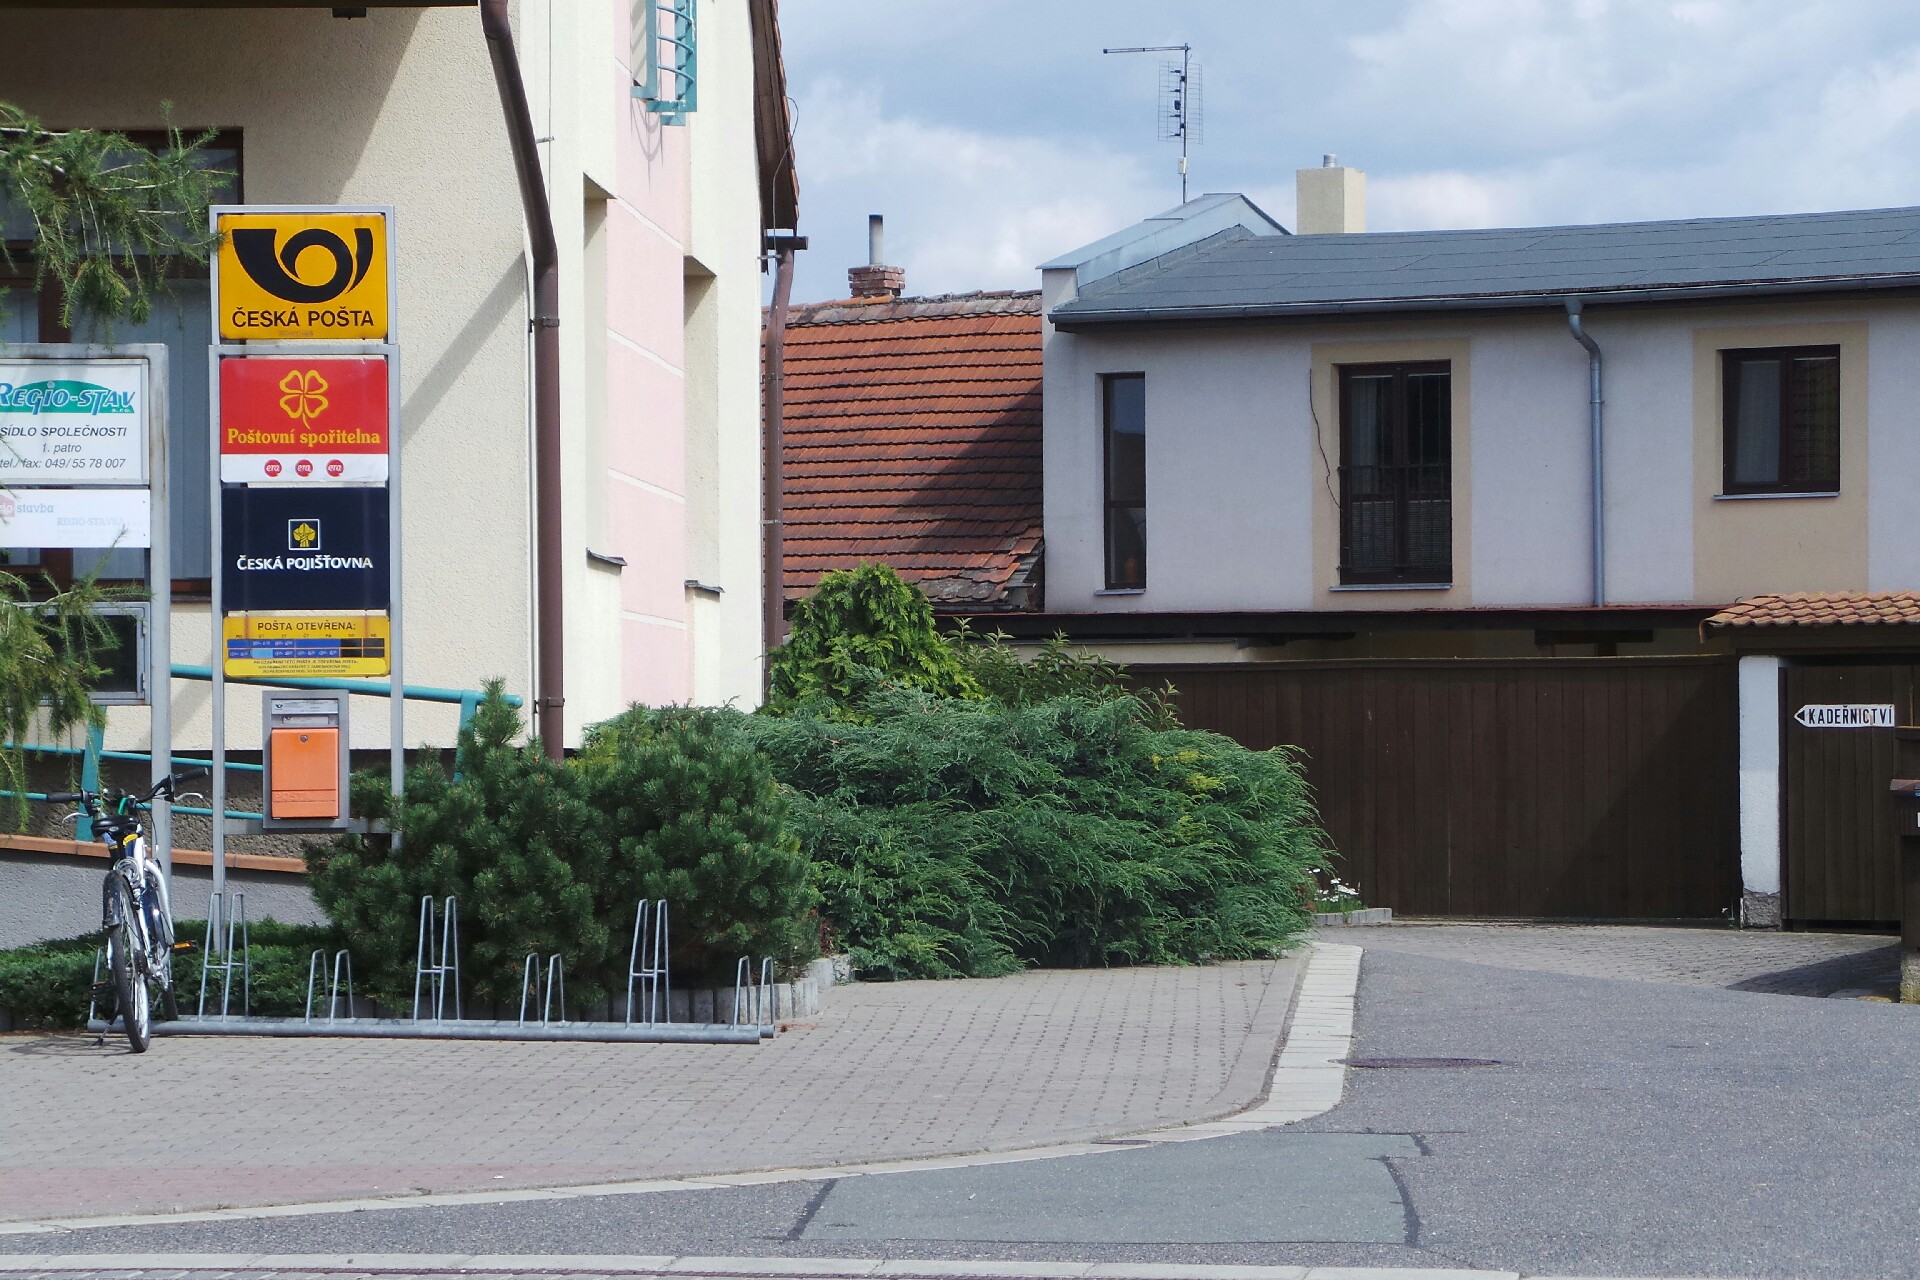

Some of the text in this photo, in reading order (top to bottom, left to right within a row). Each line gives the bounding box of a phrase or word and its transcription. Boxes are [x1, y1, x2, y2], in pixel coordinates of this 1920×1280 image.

[232, 306, 374, 328] ČESKÁ POŠTA
[0, 424, 127, 437] SÍDLO SPOLEČNOSTI
[228, 428, 380, 446] Poštovní spořitelna
[42, 443, 82, 455] 1. patro
[105, 459, 126, 468] 007
[297, 465, 311, 473] era
[328, 464, 342, 472] era
[17, 503, 54, 513] stavba
[237, 555, 373, 571] ČESKÁ POJIŠŤOVNA
[258, 620, 356, 630] POŠTA OTEVŘENA:
[1809, 705, 1892, 724] KADEŘNICTVÍ
